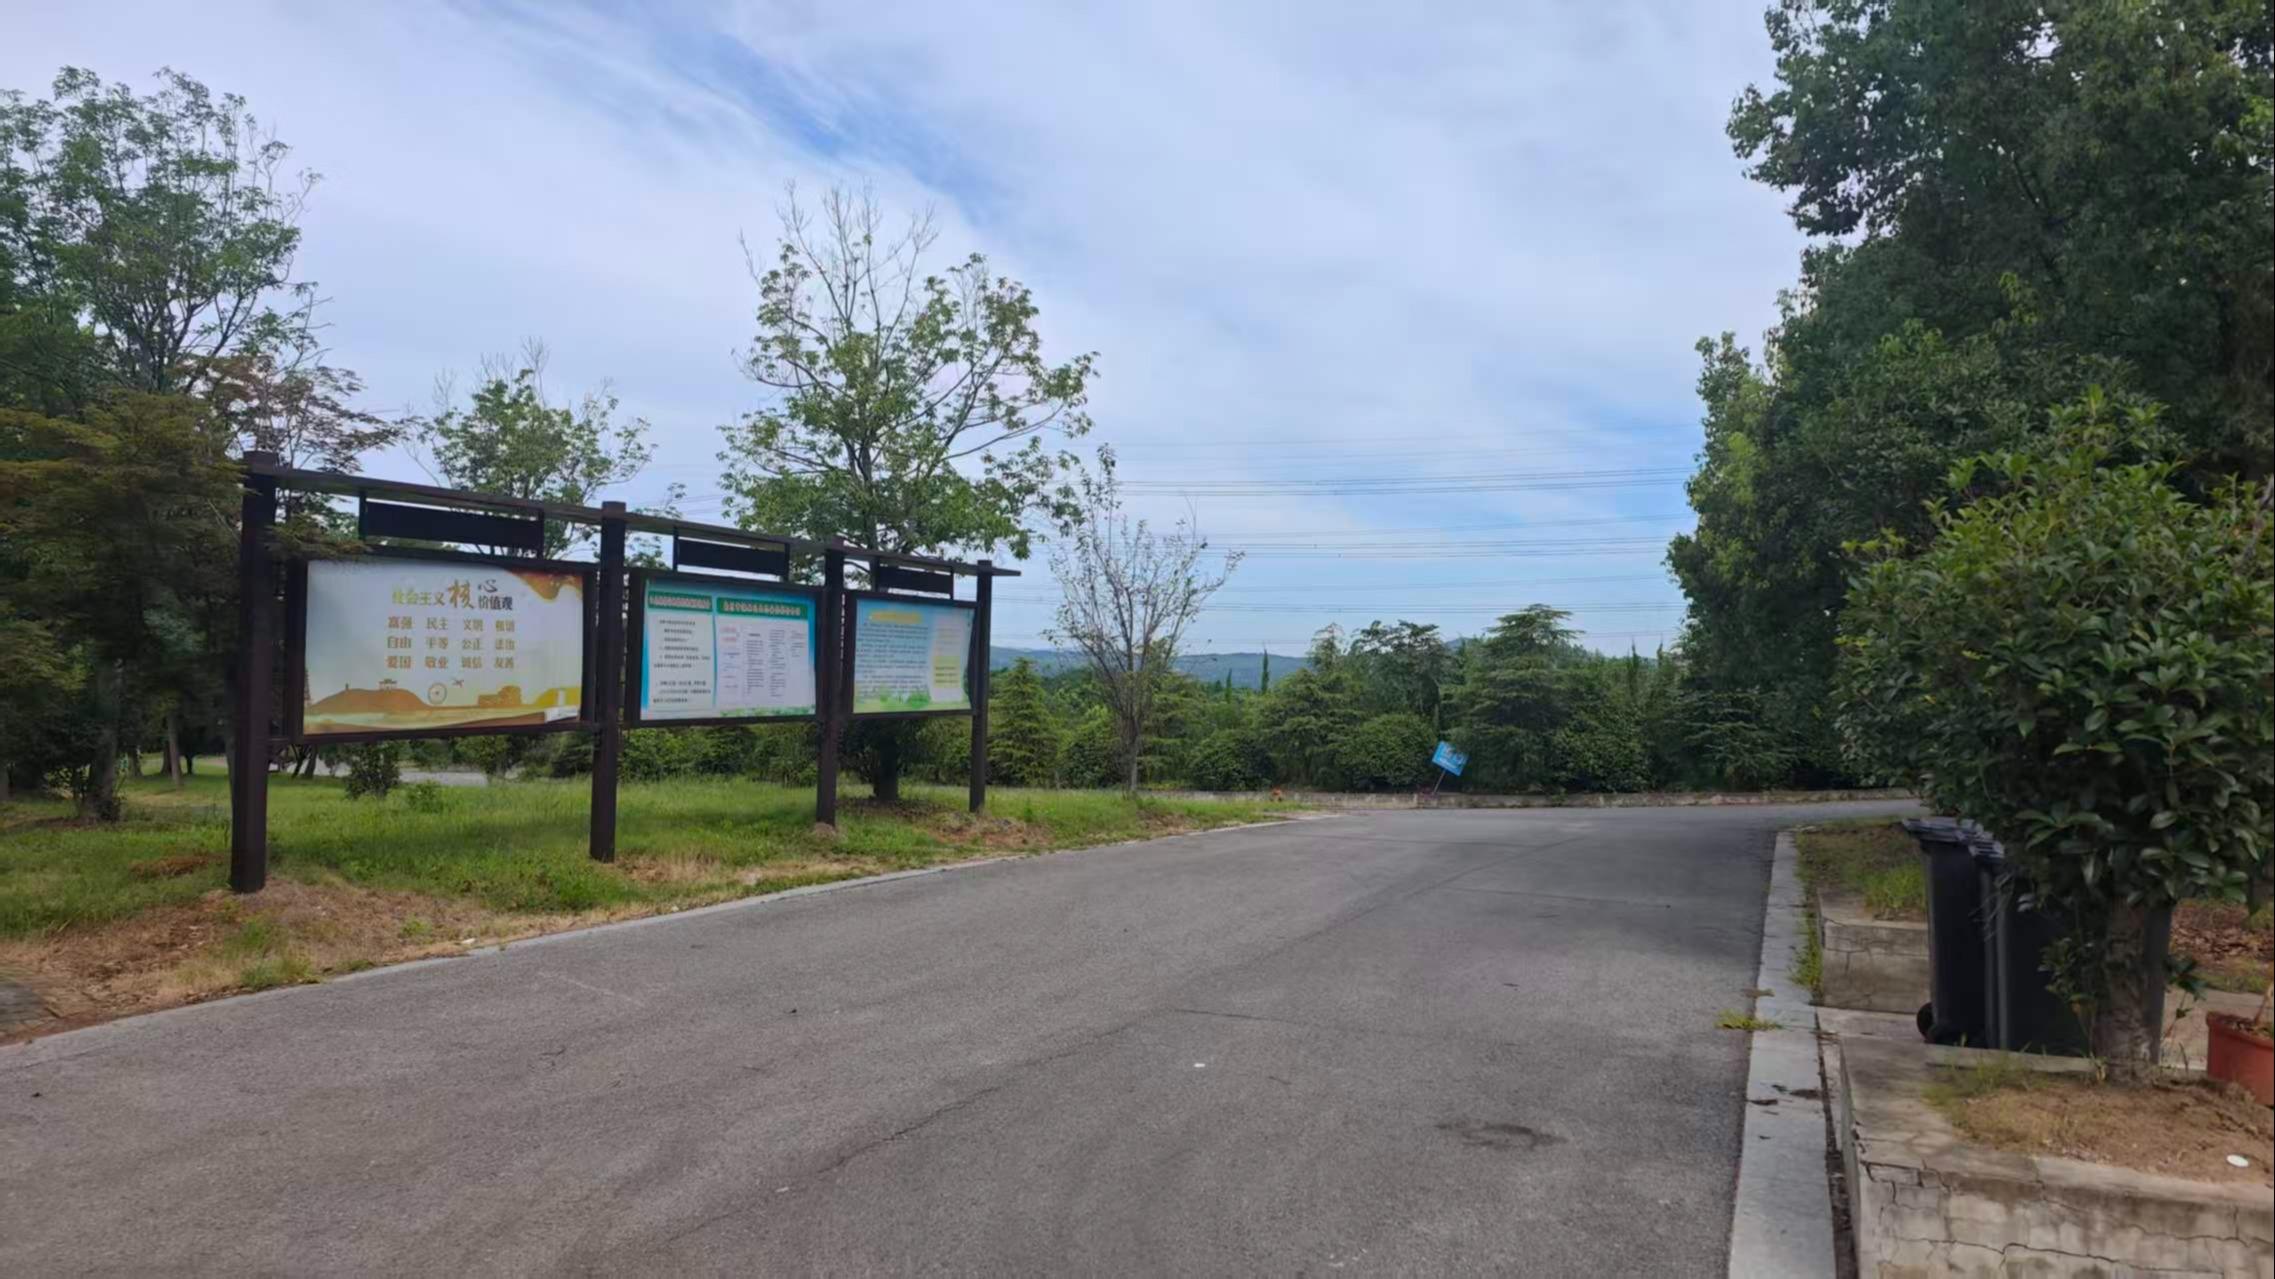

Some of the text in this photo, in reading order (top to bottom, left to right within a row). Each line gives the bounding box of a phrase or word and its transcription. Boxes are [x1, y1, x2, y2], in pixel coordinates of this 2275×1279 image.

[426, 617, 448, 630] 民主
[387, 636, 411, 648] 自由
[462, 638, 480, 650] 公正
